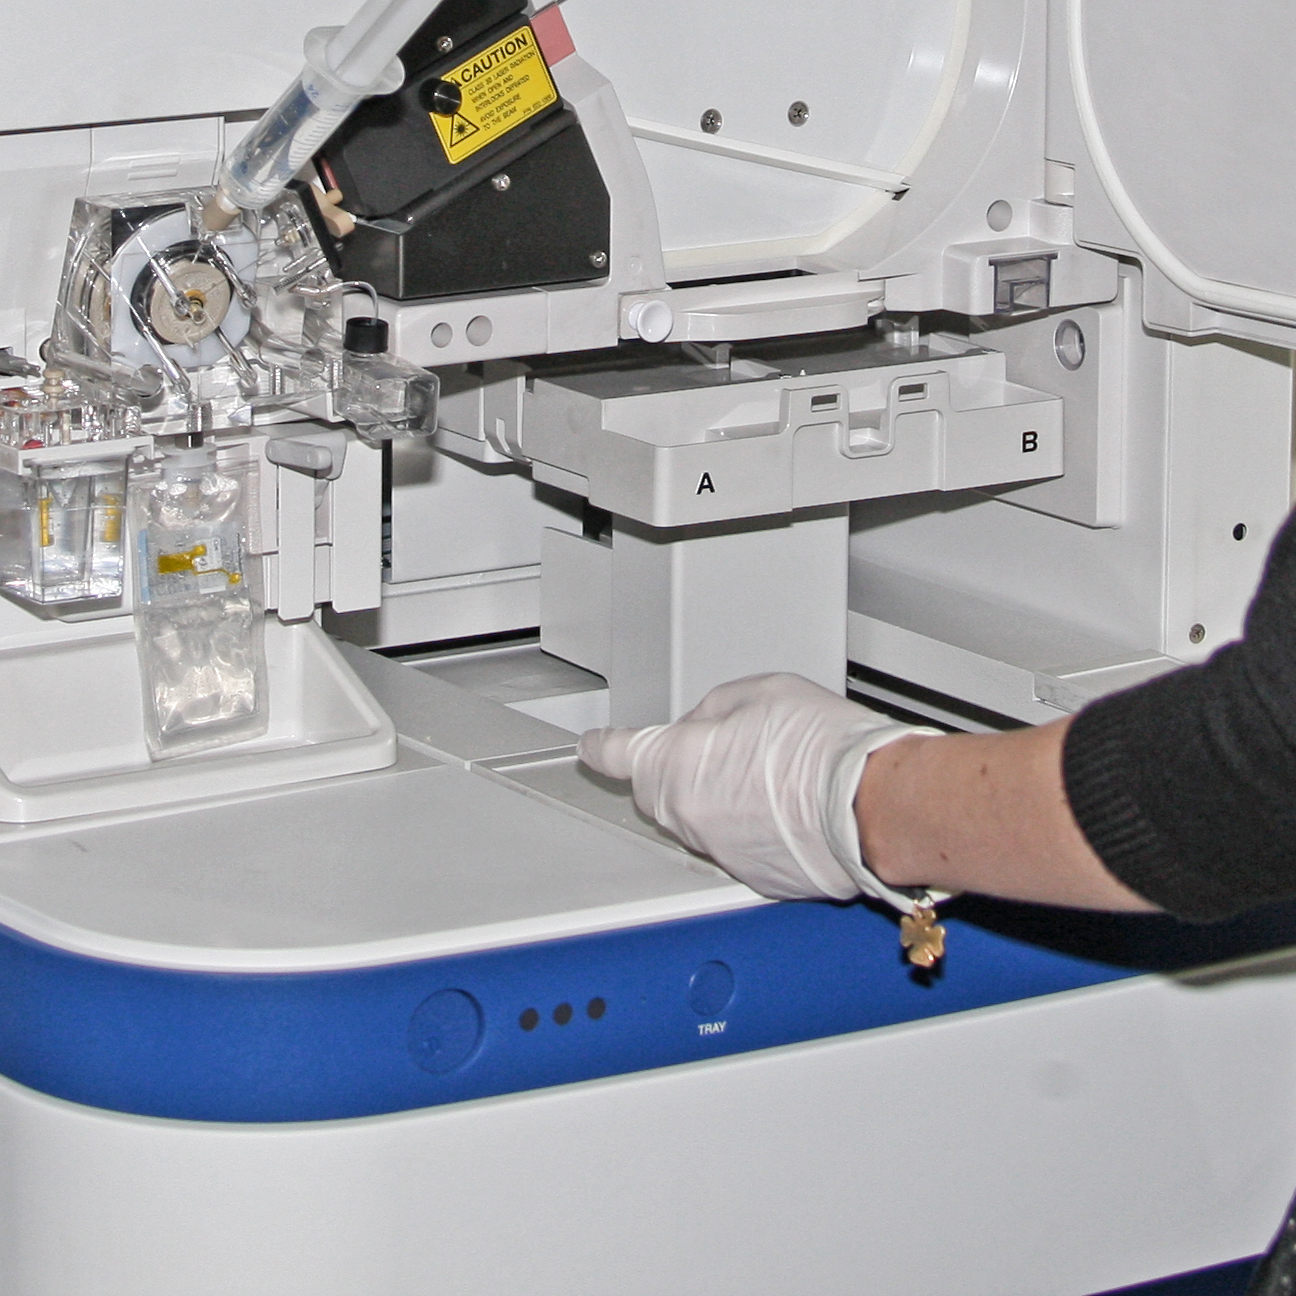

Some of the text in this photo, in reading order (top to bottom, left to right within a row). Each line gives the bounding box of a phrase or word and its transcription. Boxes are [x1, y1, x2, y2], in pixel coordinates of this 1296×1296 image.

[461, 33, 528, 82] CAUTION
[487, 83, 502, 94] OPEN
[502, 74, 514, 86] AND
[492, 116, 503, 126] THE
[1021, 431, 1038, 453] B
[696, 472, 716, 495] A
[698, 1021, 727, 1035] TRAY
